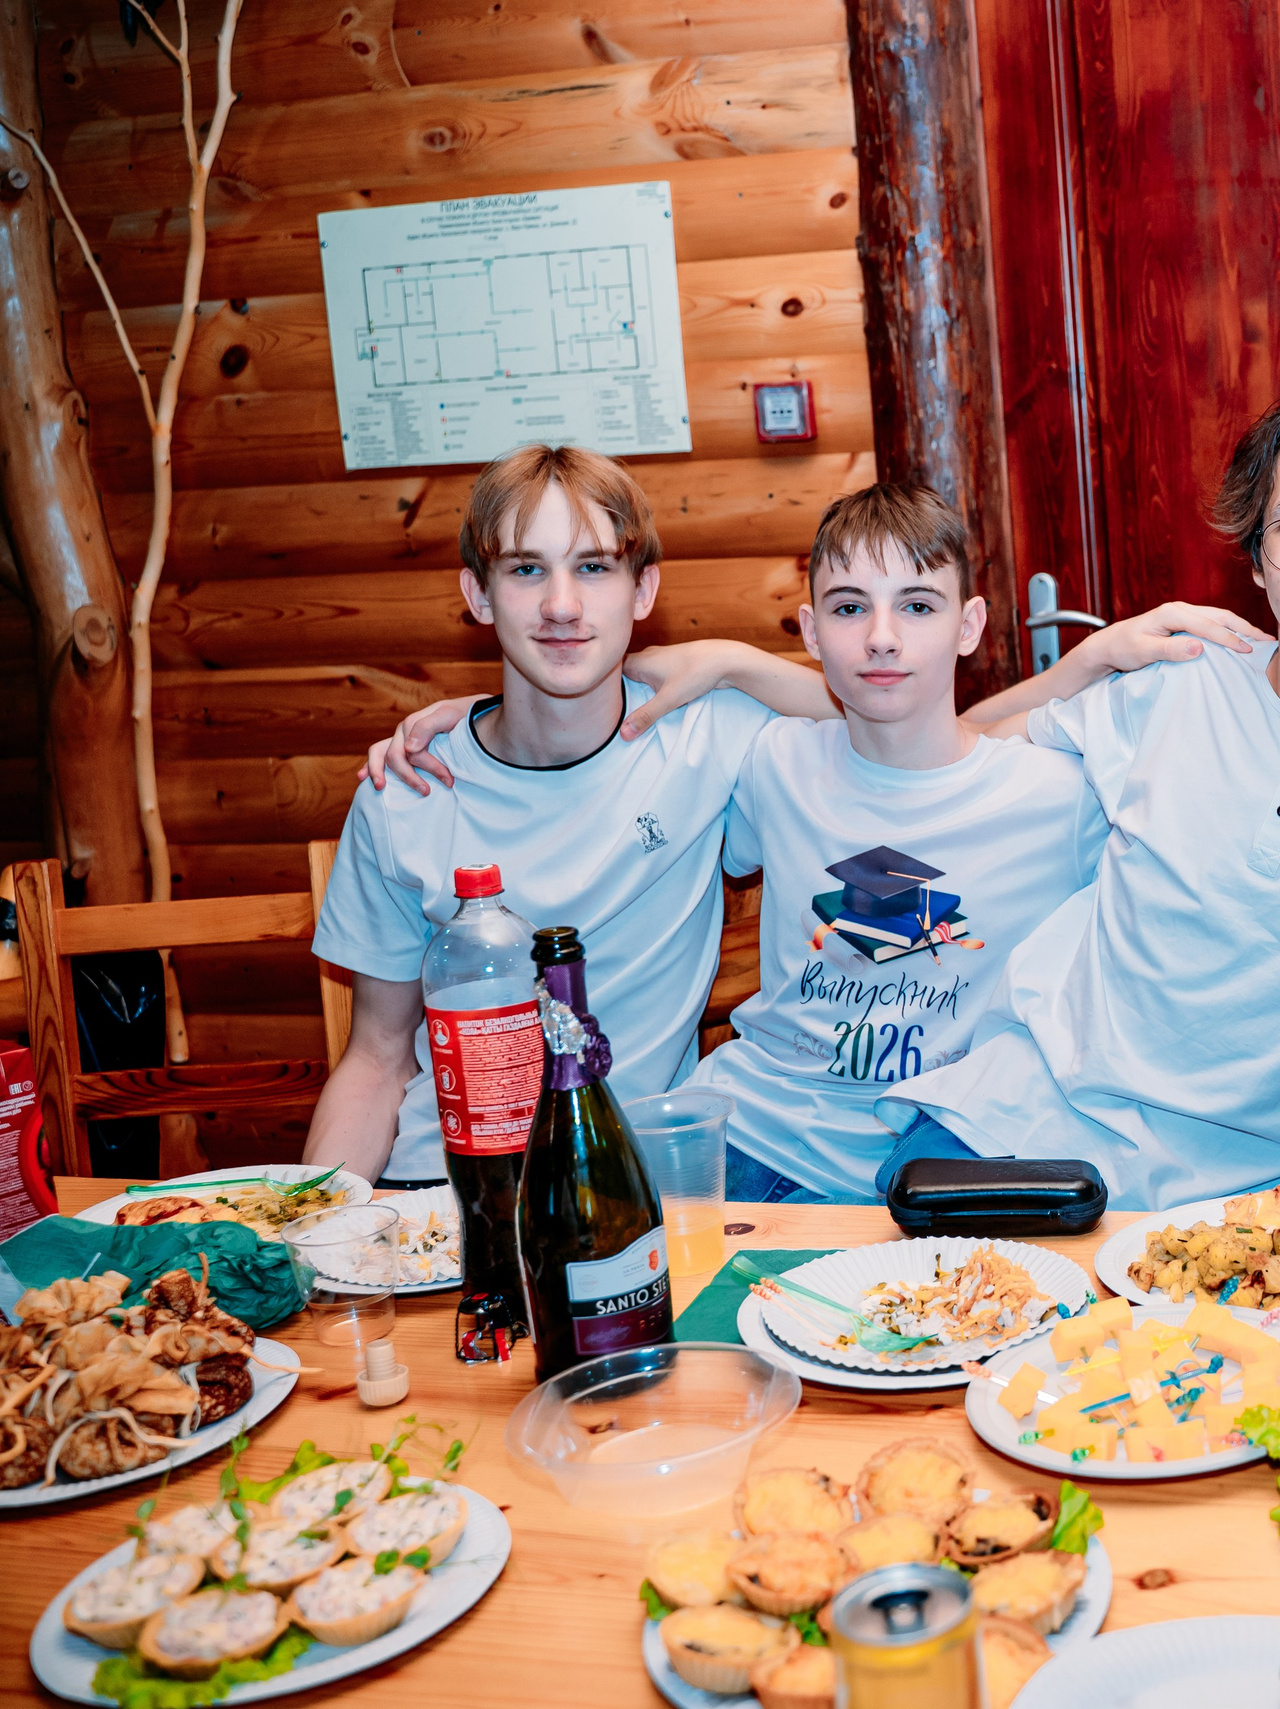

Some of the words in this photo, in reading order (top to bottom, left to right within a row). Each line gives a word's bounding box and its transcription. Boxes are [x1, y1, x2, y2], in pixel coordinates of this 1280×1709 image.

[440, 202, 470, 213] ПЛАН
[472, 195, 538, 210] ЭВАКУАЦИИ
[799, 958, 969, 1035] Выпускник
[827, 1020, 925, 1082] 2026
[595, 1289, 650, 1315] SANTO
[652, 1273, 668, 1297] STE
